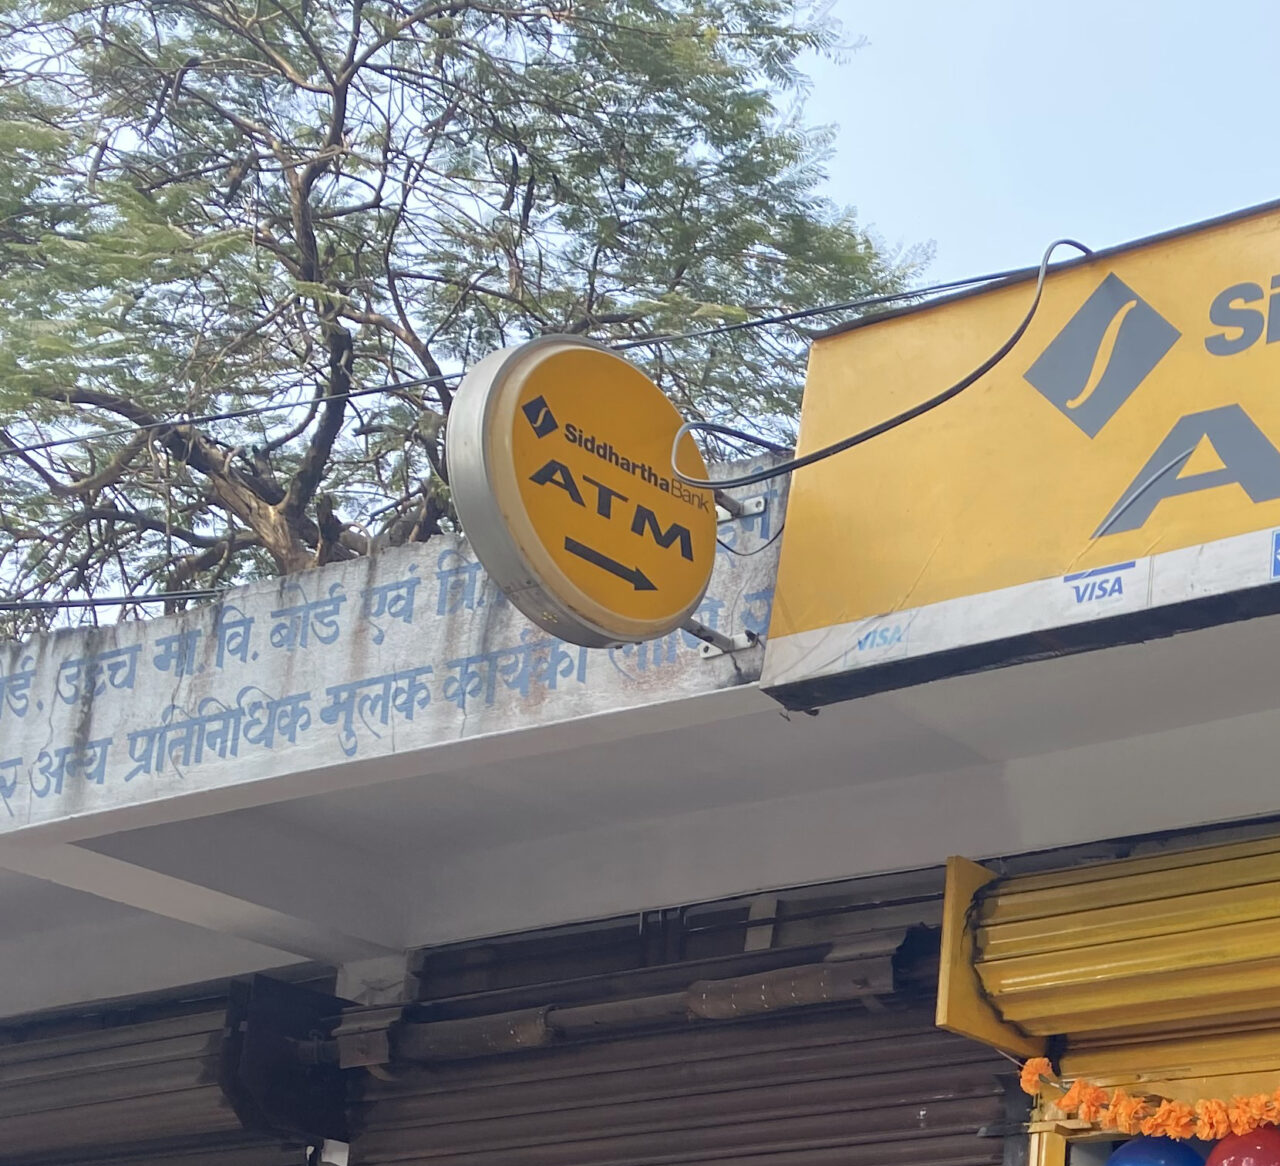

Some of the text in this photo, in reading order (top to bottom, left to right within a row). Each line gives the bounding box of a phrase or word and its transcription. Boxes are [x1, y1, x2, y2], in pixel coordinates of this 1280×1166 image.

[528, 459, 694, 562] ATM
[360, 564, 421, 646] एवं
[1072, 577, 1123, 604] VISA
[857, 624, 903, 651] VISA
